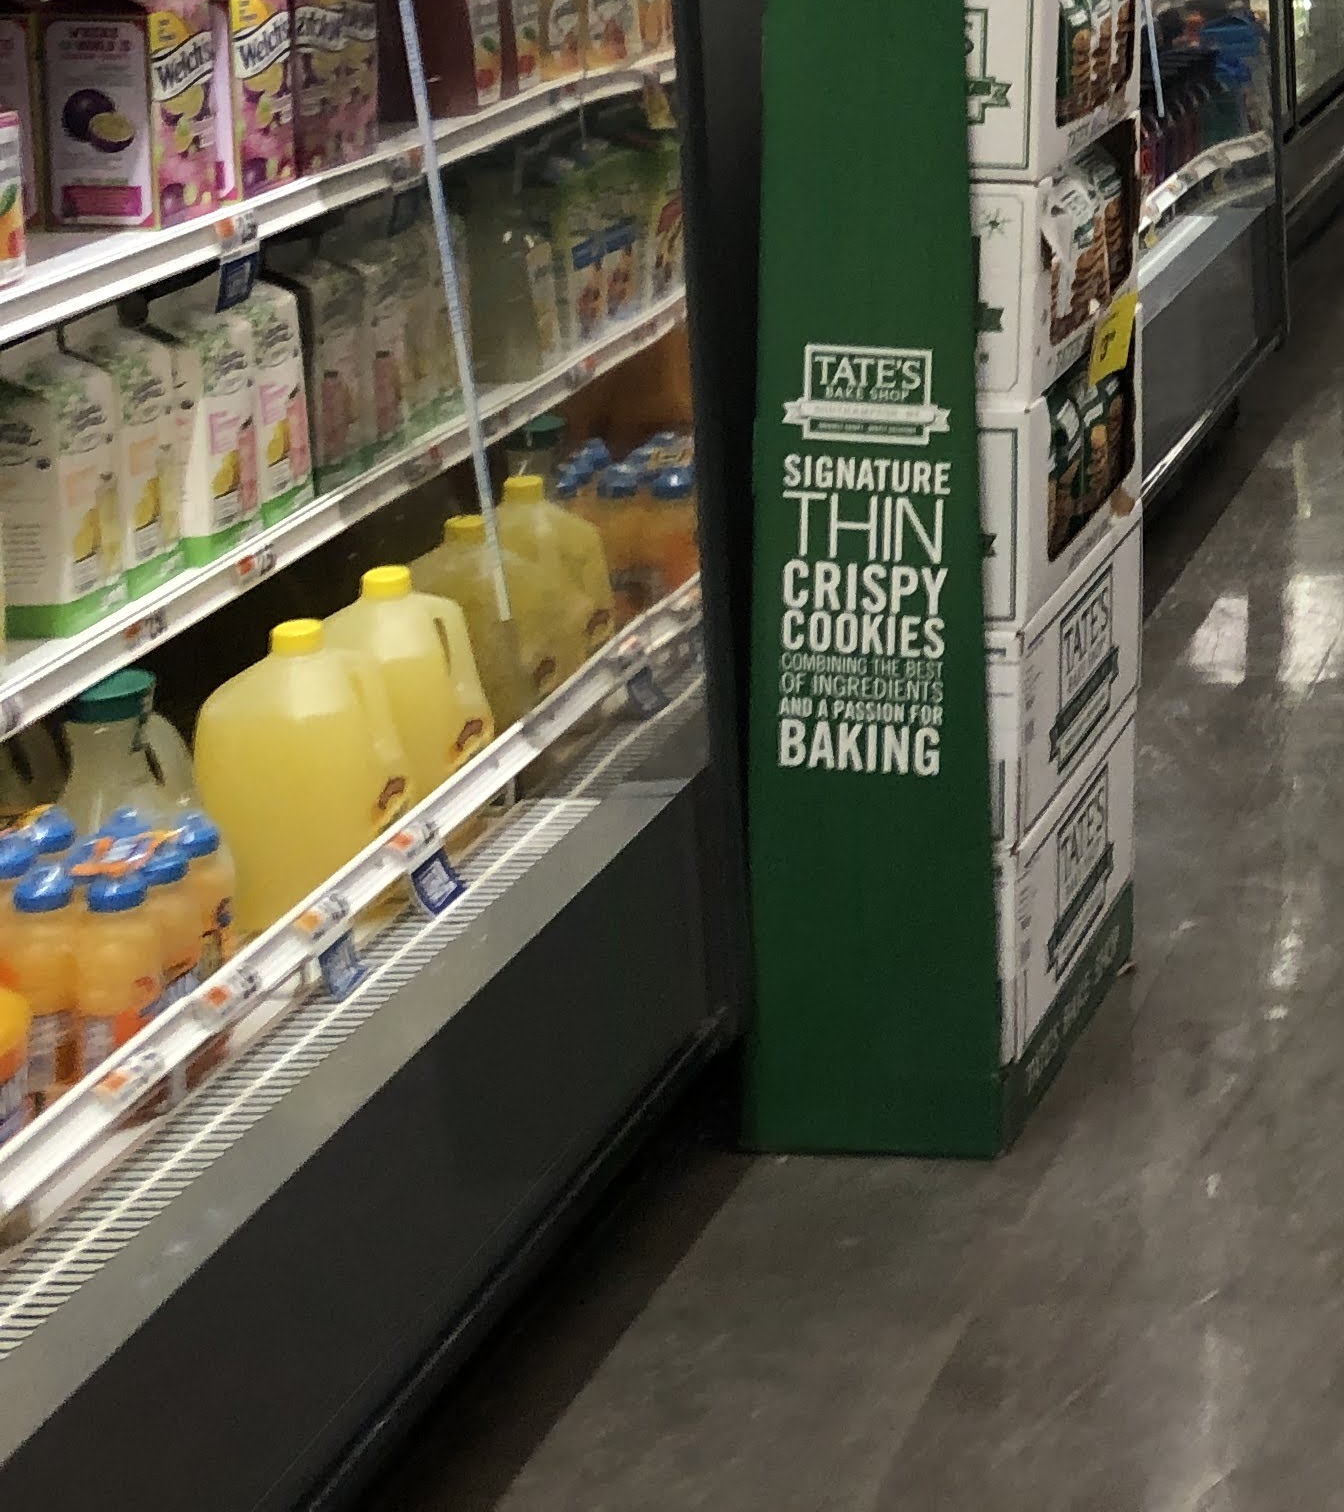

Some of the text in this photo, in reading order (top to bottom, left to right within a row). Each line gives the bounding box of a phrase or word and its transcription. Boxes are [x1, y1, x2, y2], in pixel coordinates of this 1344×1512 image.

[814, 355, 922, 392] TATE'S
[825, 385, 911, 402] BAKE SHOP
[783, 453, 951, 495] SIGNATURE
[783, 490, 945, 564] THIN
[783, 559, 949, 617] CRISPY
[782, 609, 945, 660] COOKIES
[781, 652, 944, 680] COMBINING THE BEST
[781, 671, 944, 704] OF INGREDIENTS
[780, 695, 944, 727] AND A PASSION FOR
[779, 718, 941, 777] BAKING
